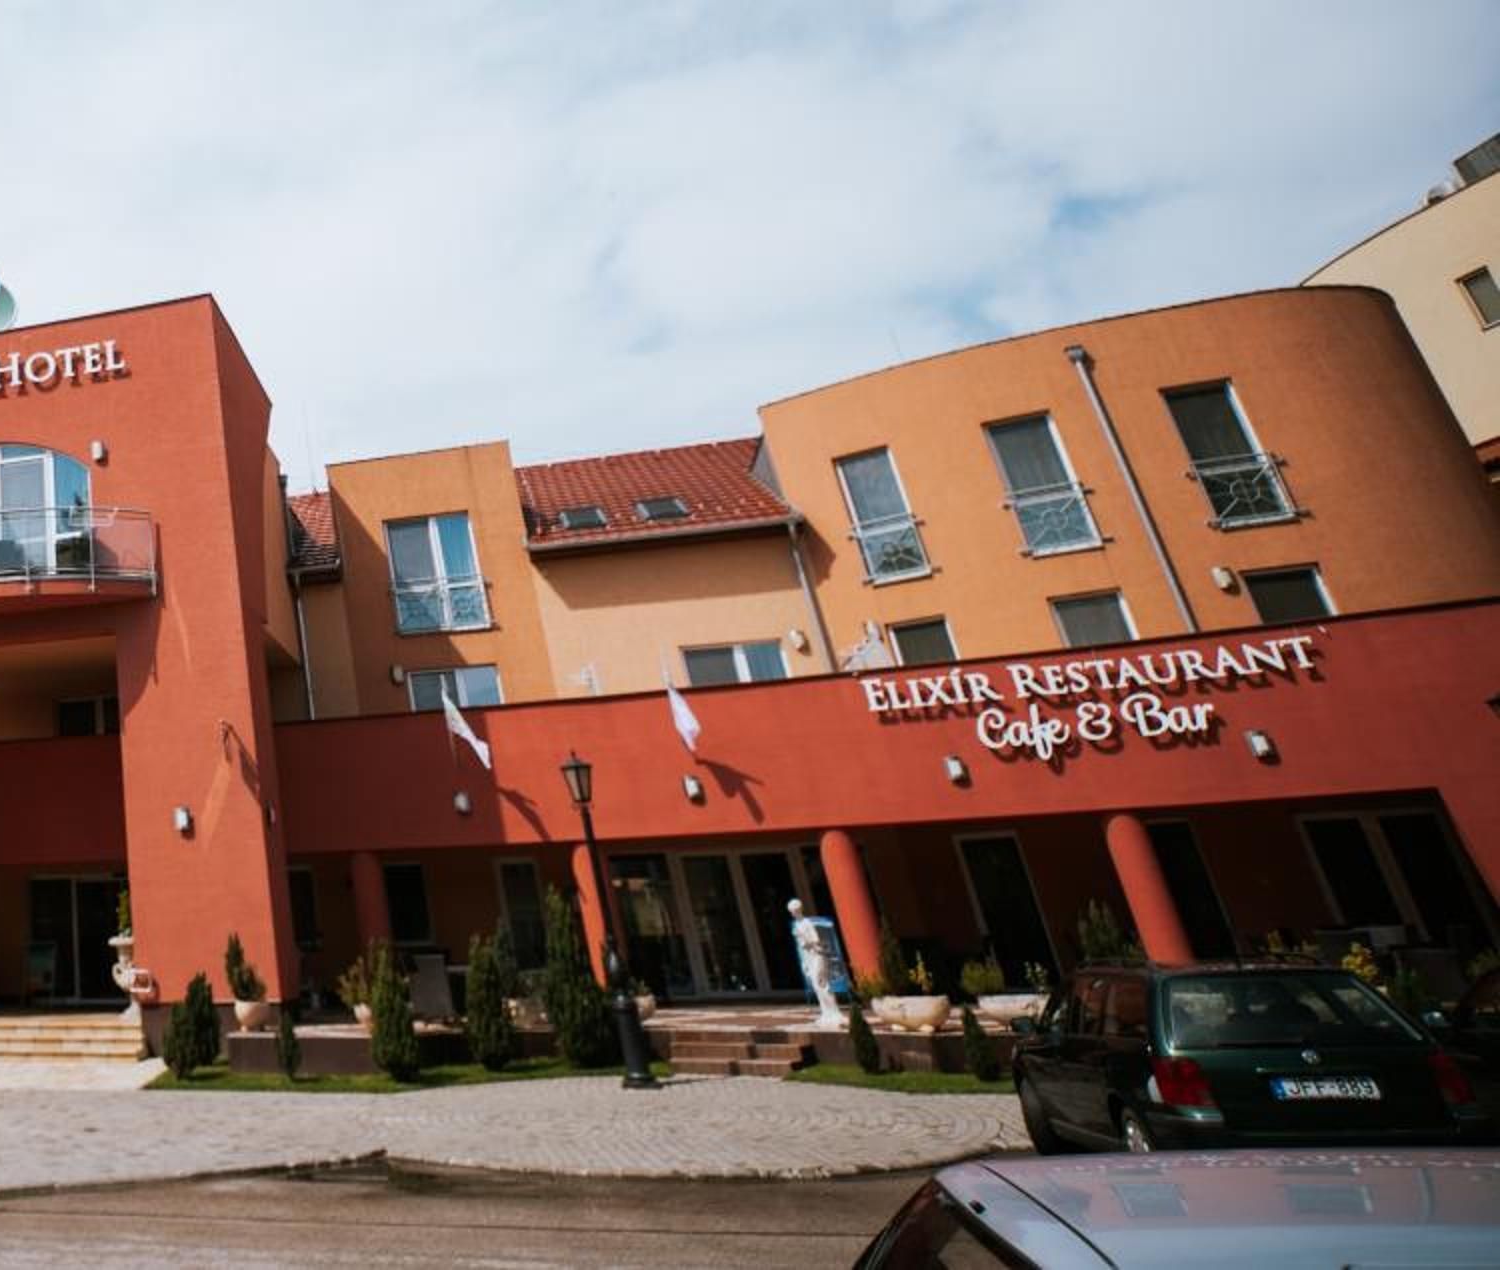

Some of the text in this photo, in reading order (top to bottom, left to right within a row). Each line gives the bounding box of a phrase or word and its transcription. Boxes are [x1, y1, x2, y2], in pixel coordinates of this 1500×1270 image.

[860, 635, 1315, 712] ELIXÍR RESTAURANT
[976, 691, 1214, 760] Cafe & Bar
